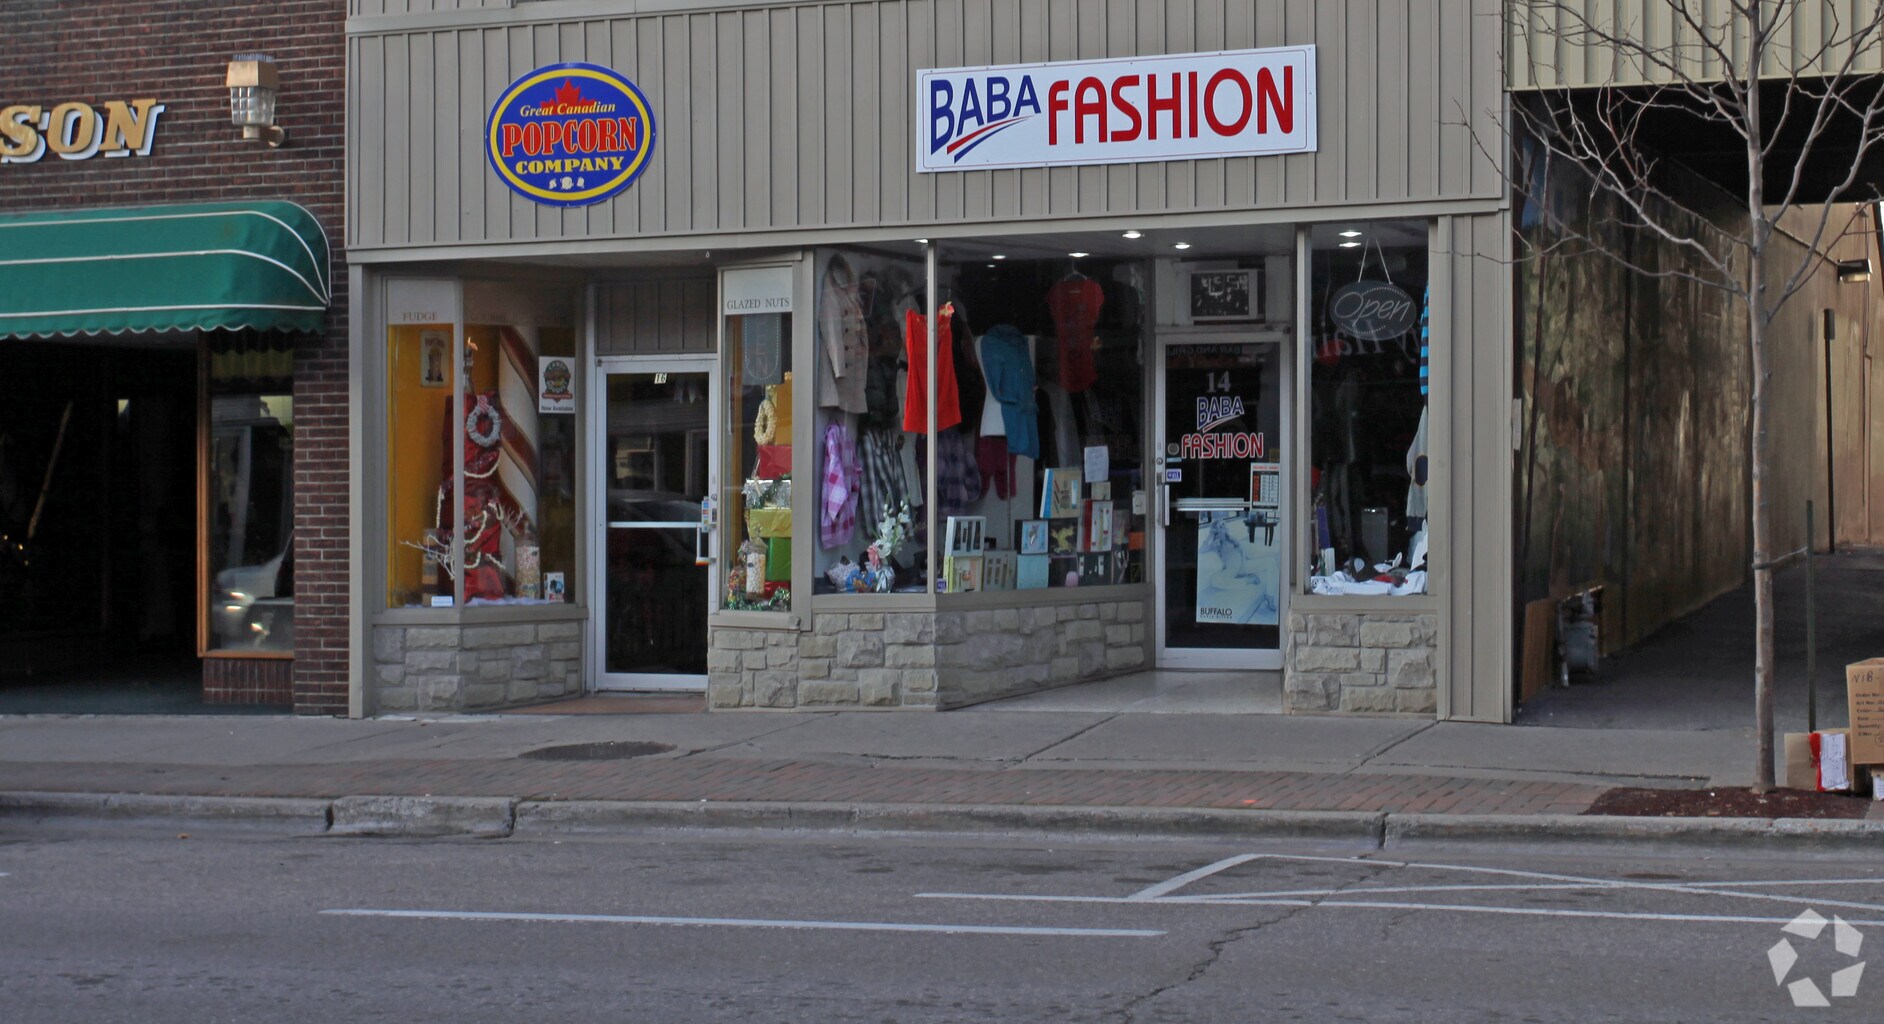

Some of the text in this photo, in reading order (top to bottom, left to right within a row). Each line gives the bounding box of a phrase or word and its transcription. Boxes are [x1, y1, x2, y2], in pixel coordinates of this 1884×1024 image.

[520, 101, 616, 117] Great Canadian
[930, 65, 1294, 156] BABA FASHION
[502, 117, 637, 157] POPCORN
[515, 156, 624, 174] COMPANY
[726, 297, 790, 310] GLAZED NUTS
[1334, 291, 1411, 327] Open
[402, 312, 439, 322] FUDGE
[655, 373, 667, 383] 16
[1206, 370, 1232, 393] 14
[1196, 396, 1245, 431] BABA
[1180, 432, 1264, 459] FASHION
[1200, 607, 1233, 616] BUFFALO
